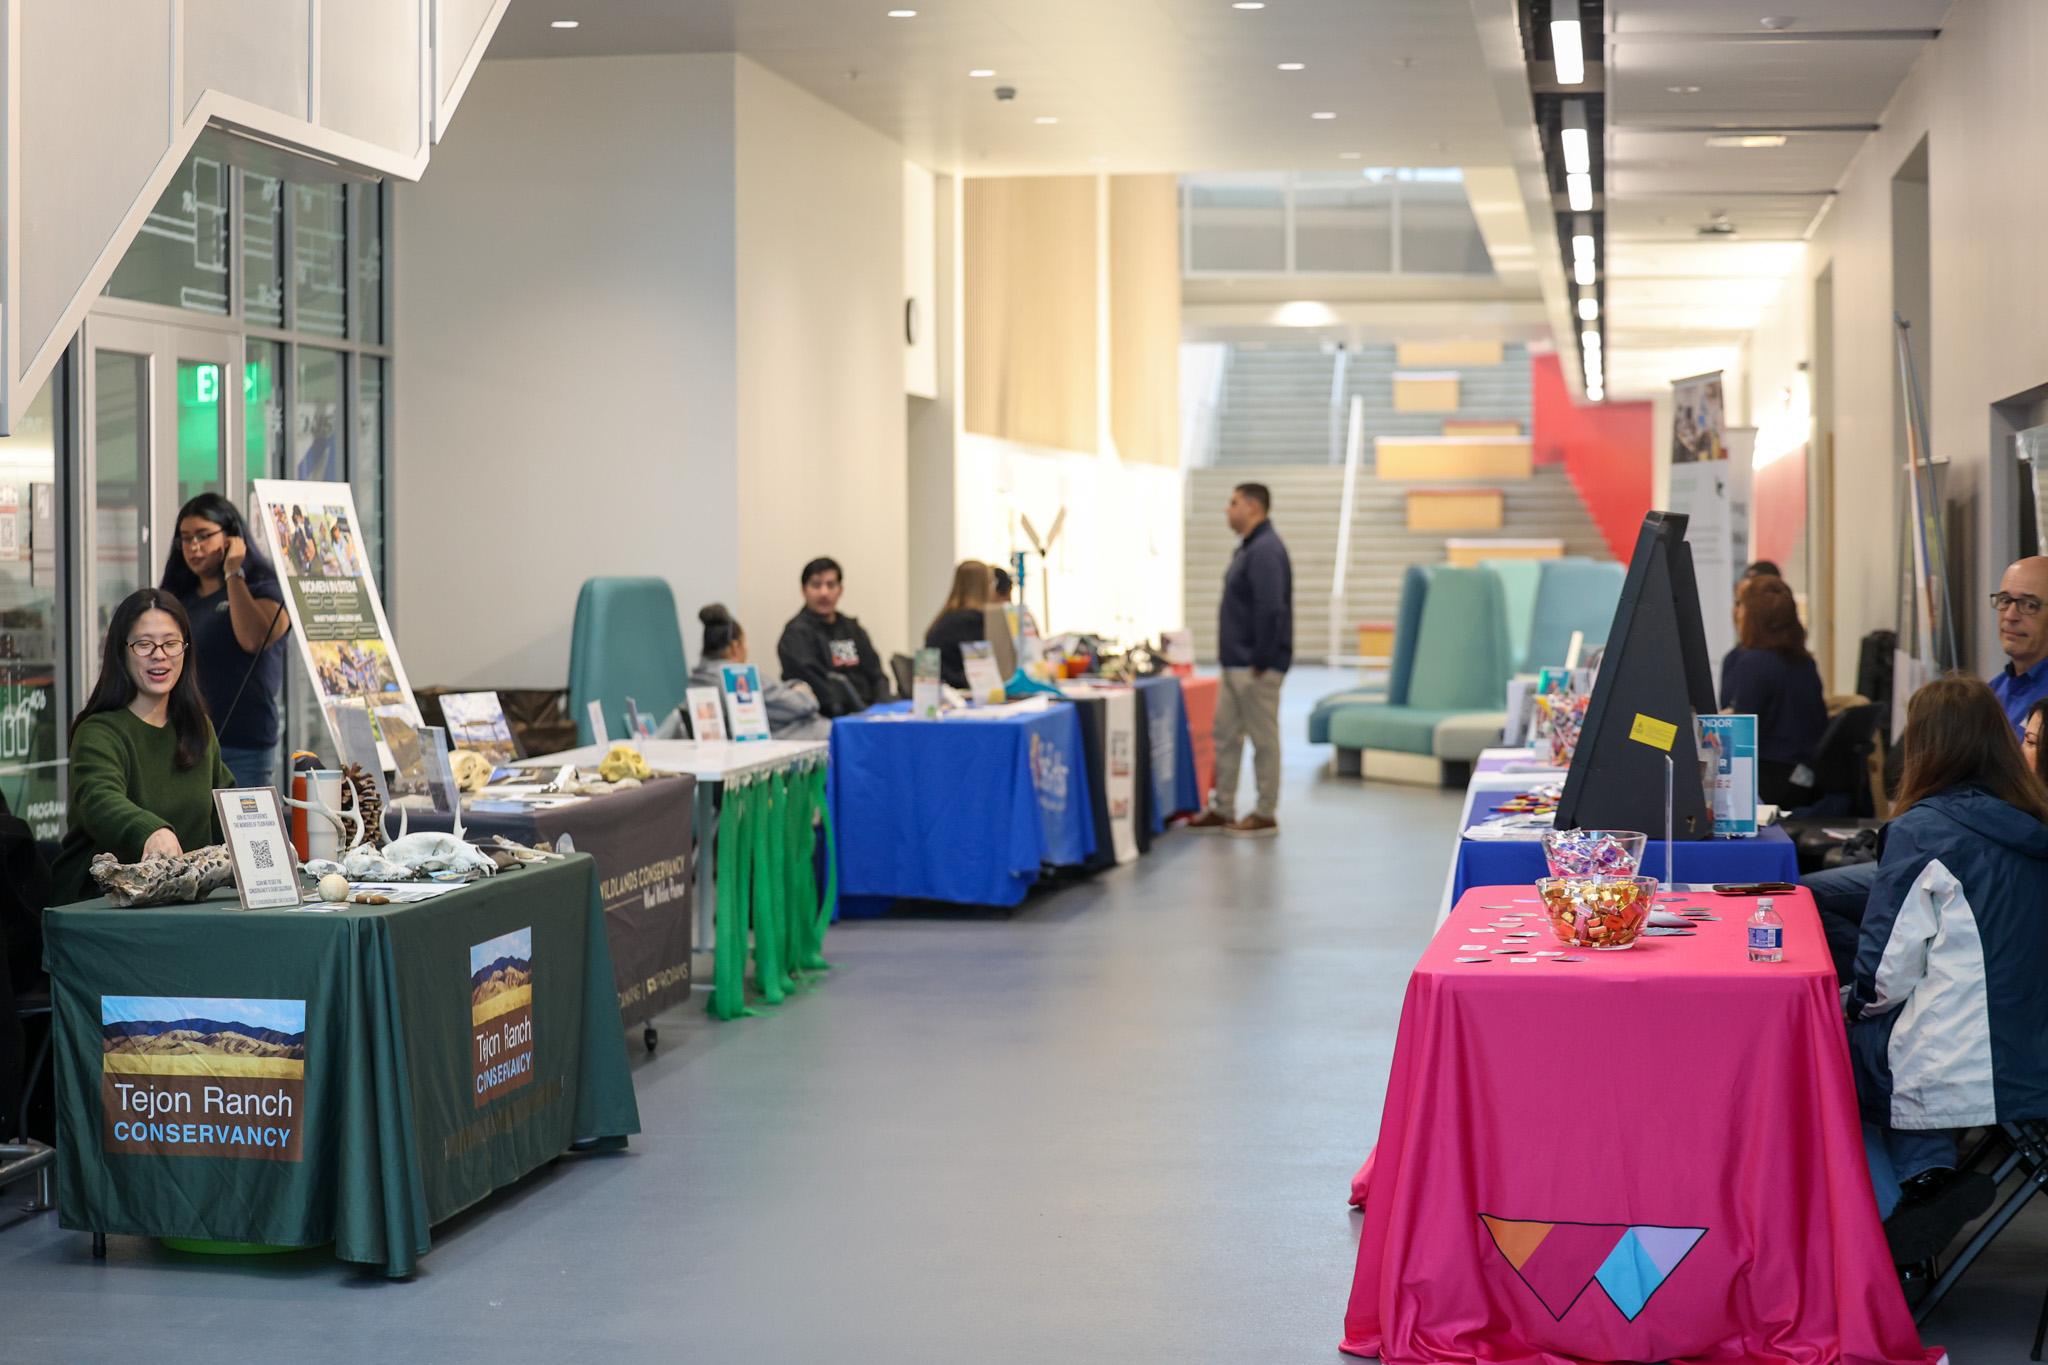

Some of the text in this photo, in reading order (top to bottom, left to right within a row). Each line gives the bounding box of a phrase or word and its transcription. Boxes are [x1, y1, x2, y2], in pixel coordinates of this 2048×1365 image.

[27, 801, 66, 820] PROGRAM
[36, 823, 60, 841] DRUM
[638, 855, 686, 887] CONSERVANCY
[476, 1015, 532, 1066] Tejon Ranch
[114, 1083, 292, 1119] Tejon Ranch
[114, 1121, 291, 1148] CONSERVANCY
